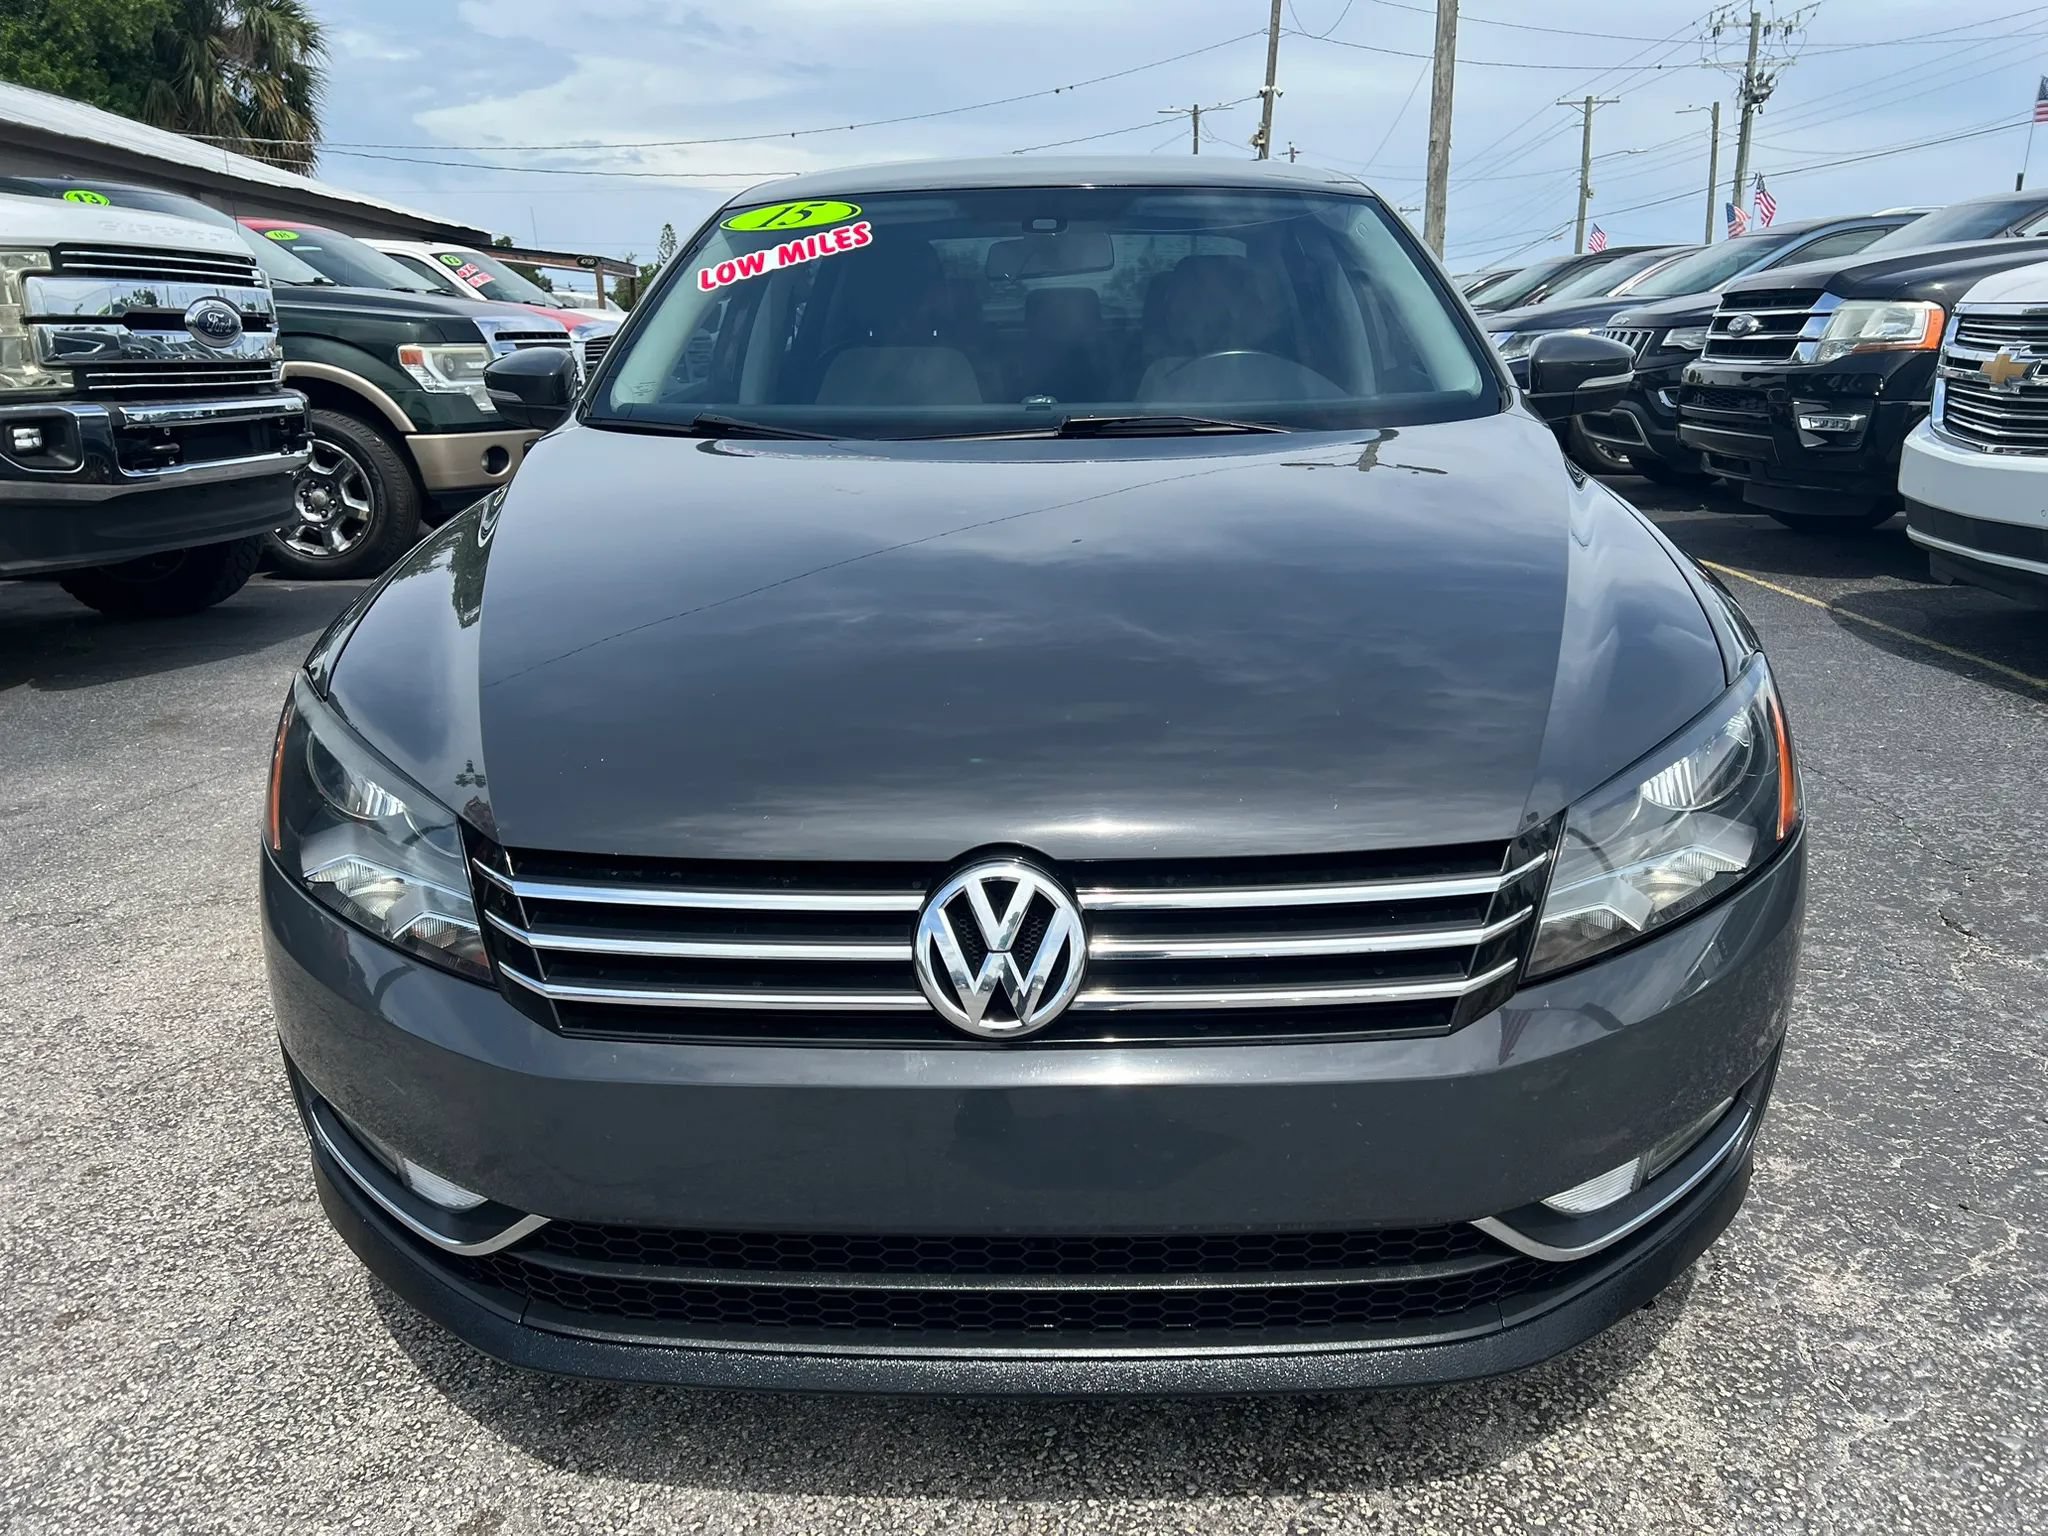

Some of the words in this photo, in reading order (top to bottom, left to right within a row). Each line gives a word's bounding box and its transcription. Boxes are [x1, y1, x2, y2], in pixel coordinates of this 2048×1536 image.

[756, 202, 829, 228] 15
[700, 252, 766, 290] LOW
[778, 223, 871, 266] MILES
[206, 311, 232, 333] Ford
[920, 868, 1082, 1032] VW
